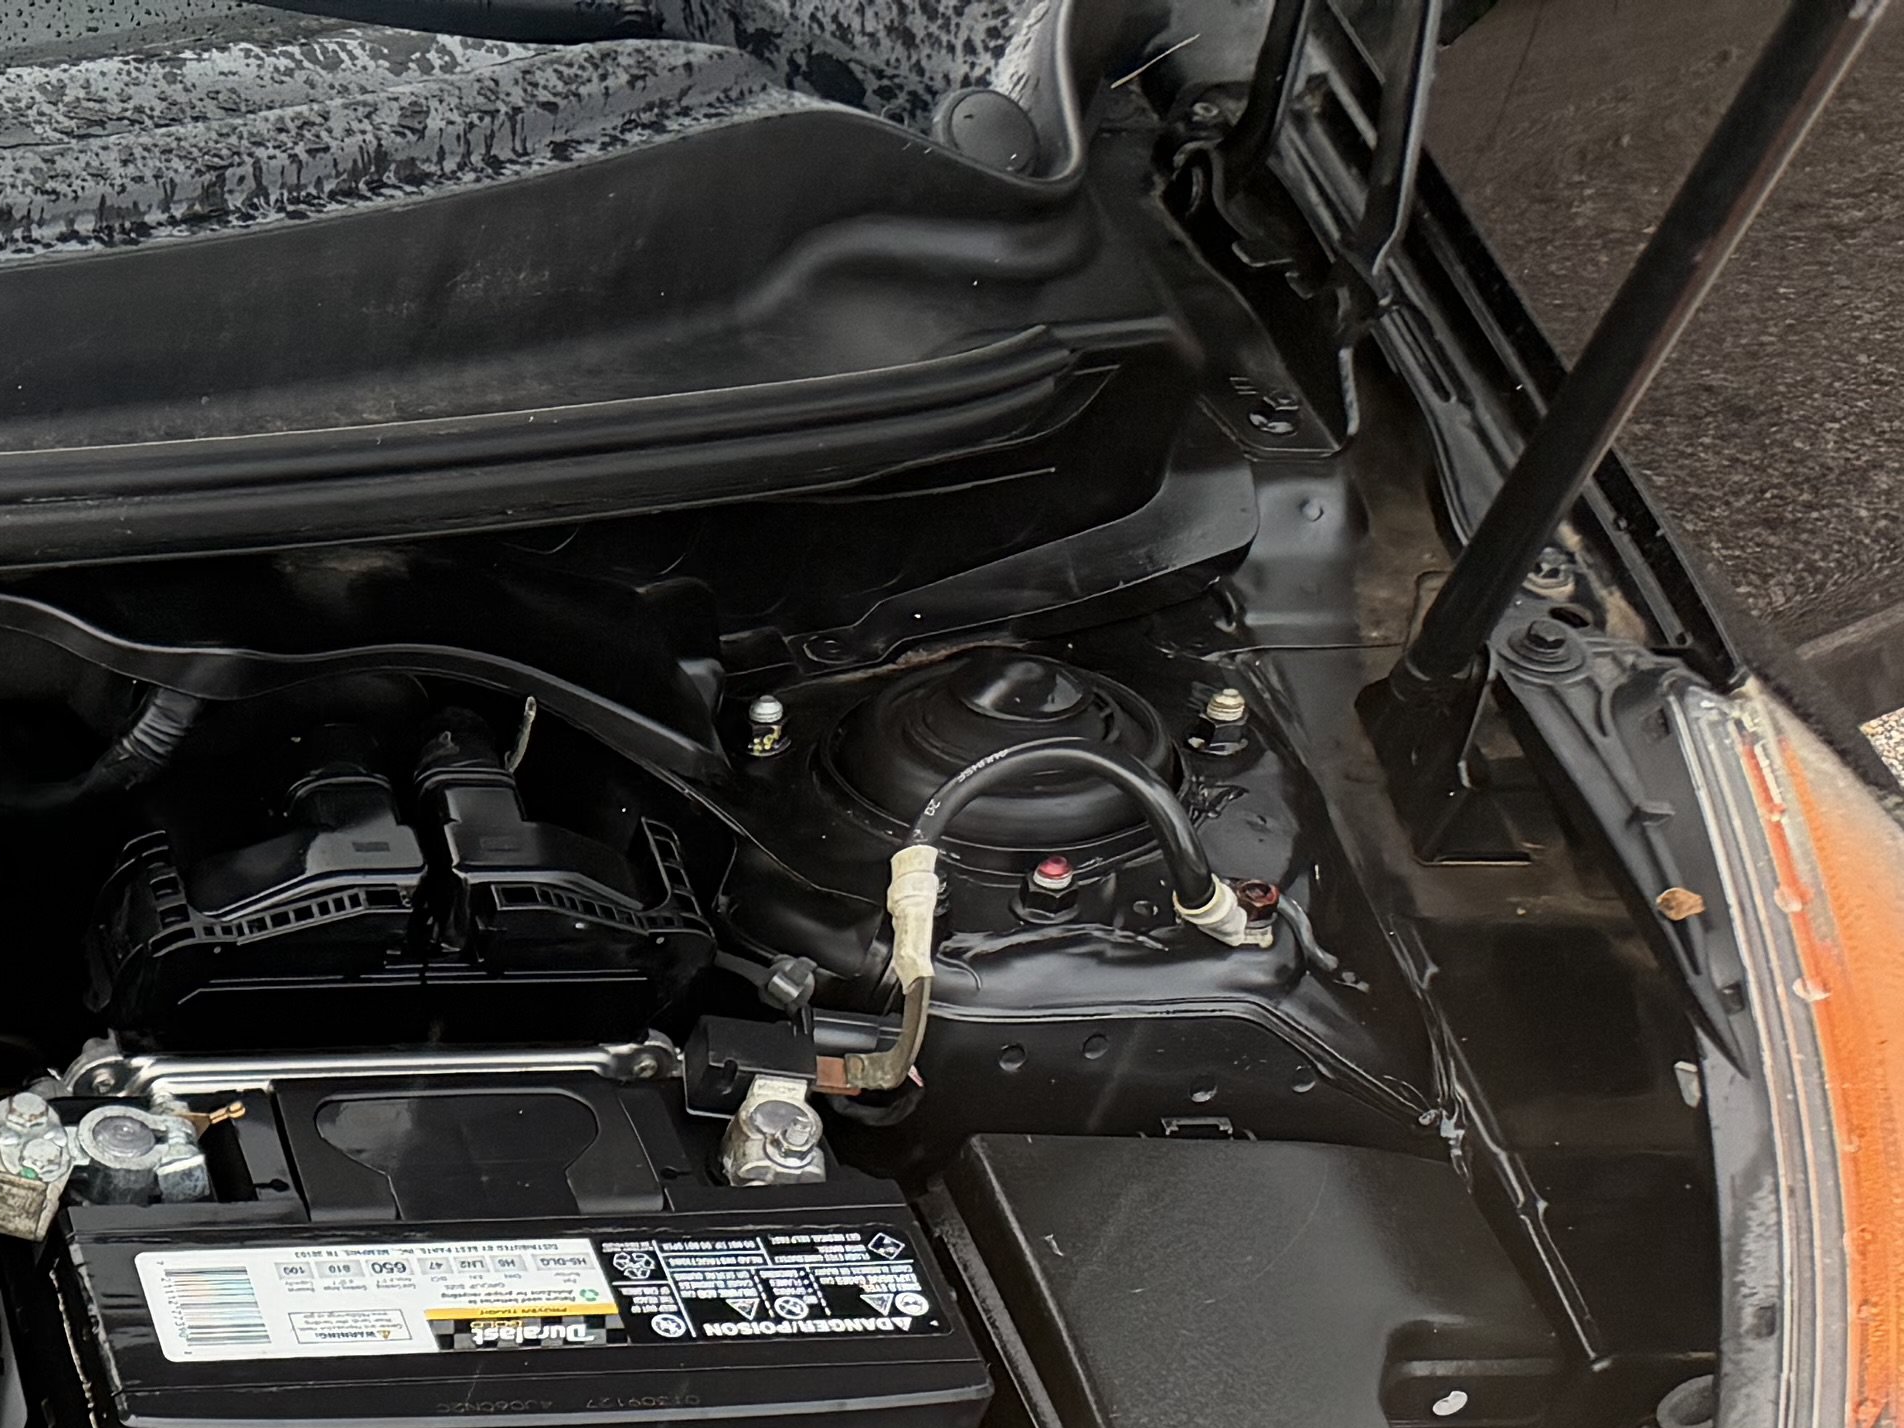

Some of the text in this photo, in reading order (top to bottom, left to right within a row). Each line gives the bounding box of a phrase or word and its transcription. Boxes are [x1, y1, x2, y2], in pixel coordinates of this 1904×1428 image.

[371, 1262, 407, 1274] 650
[471, 1324, 594, 1345] Duralast
[703, 1318, 894, 1336] DANGER/POISON
